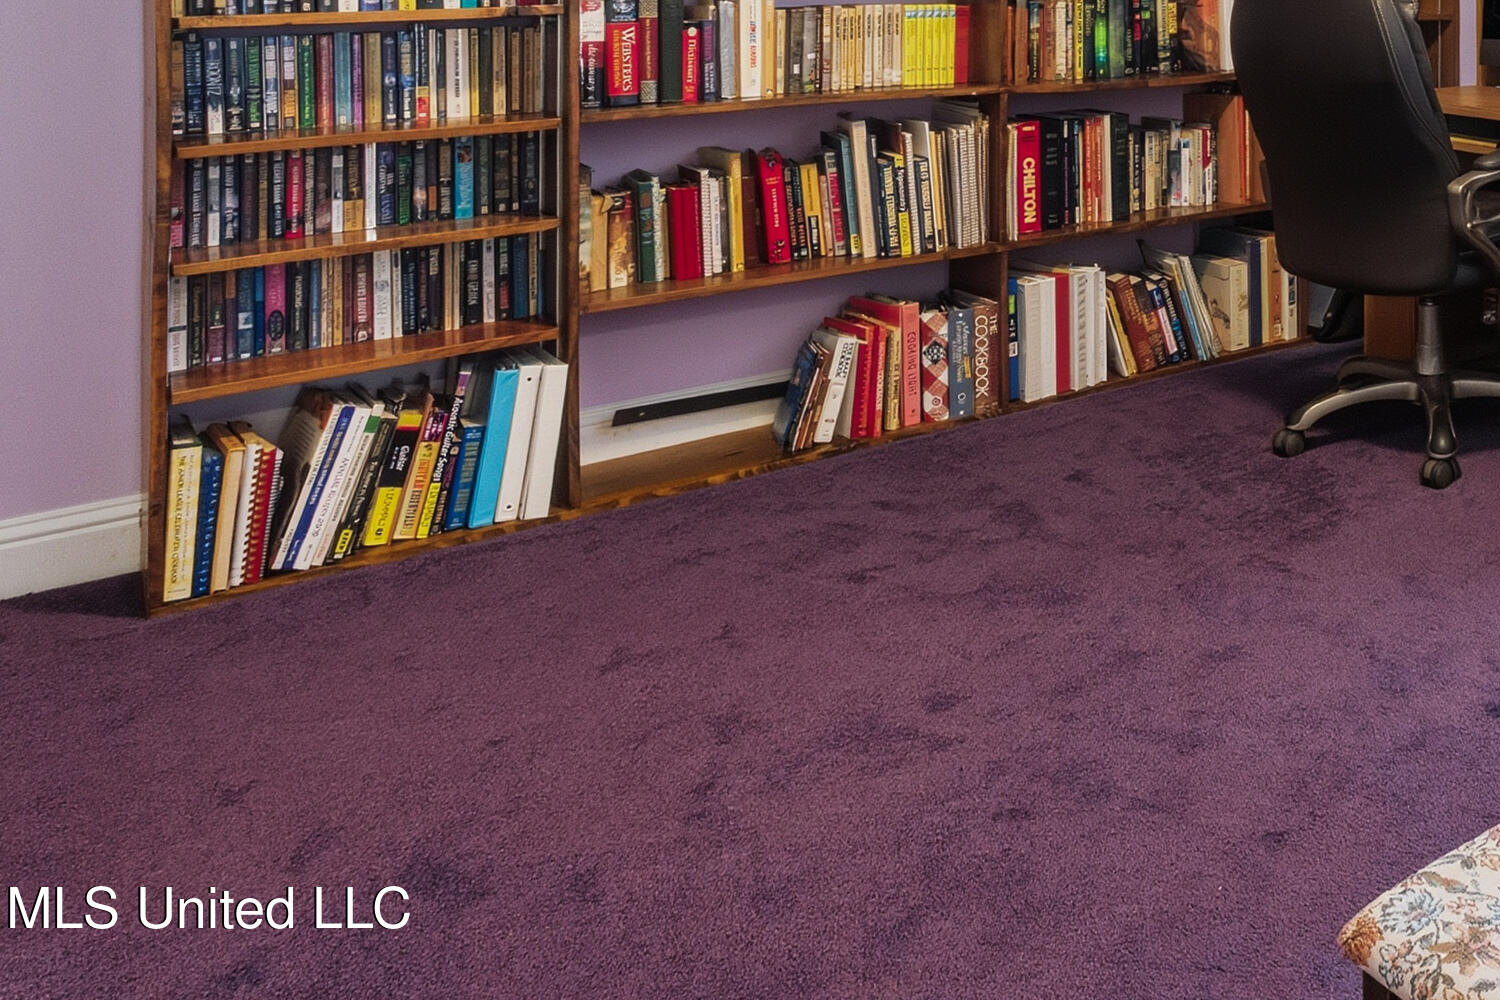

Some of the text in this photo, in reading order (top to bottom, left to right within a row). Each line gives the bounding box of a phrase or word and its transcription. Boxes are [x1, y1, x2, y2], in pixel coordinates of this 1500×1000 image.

[207, 59, 223, 97] KOONTZ
[621, 26, 637, 92] WEBSTER'S
[1023, 157, 1037, 224] CHILTON
[974, 315, 989, 399] COOKBOOK
[989, 313, 999, 335] THE
[907, 331, 918, 397] COOKING LIGHT
[433, 396, 463, 482] Acoustic Guitar Songs
